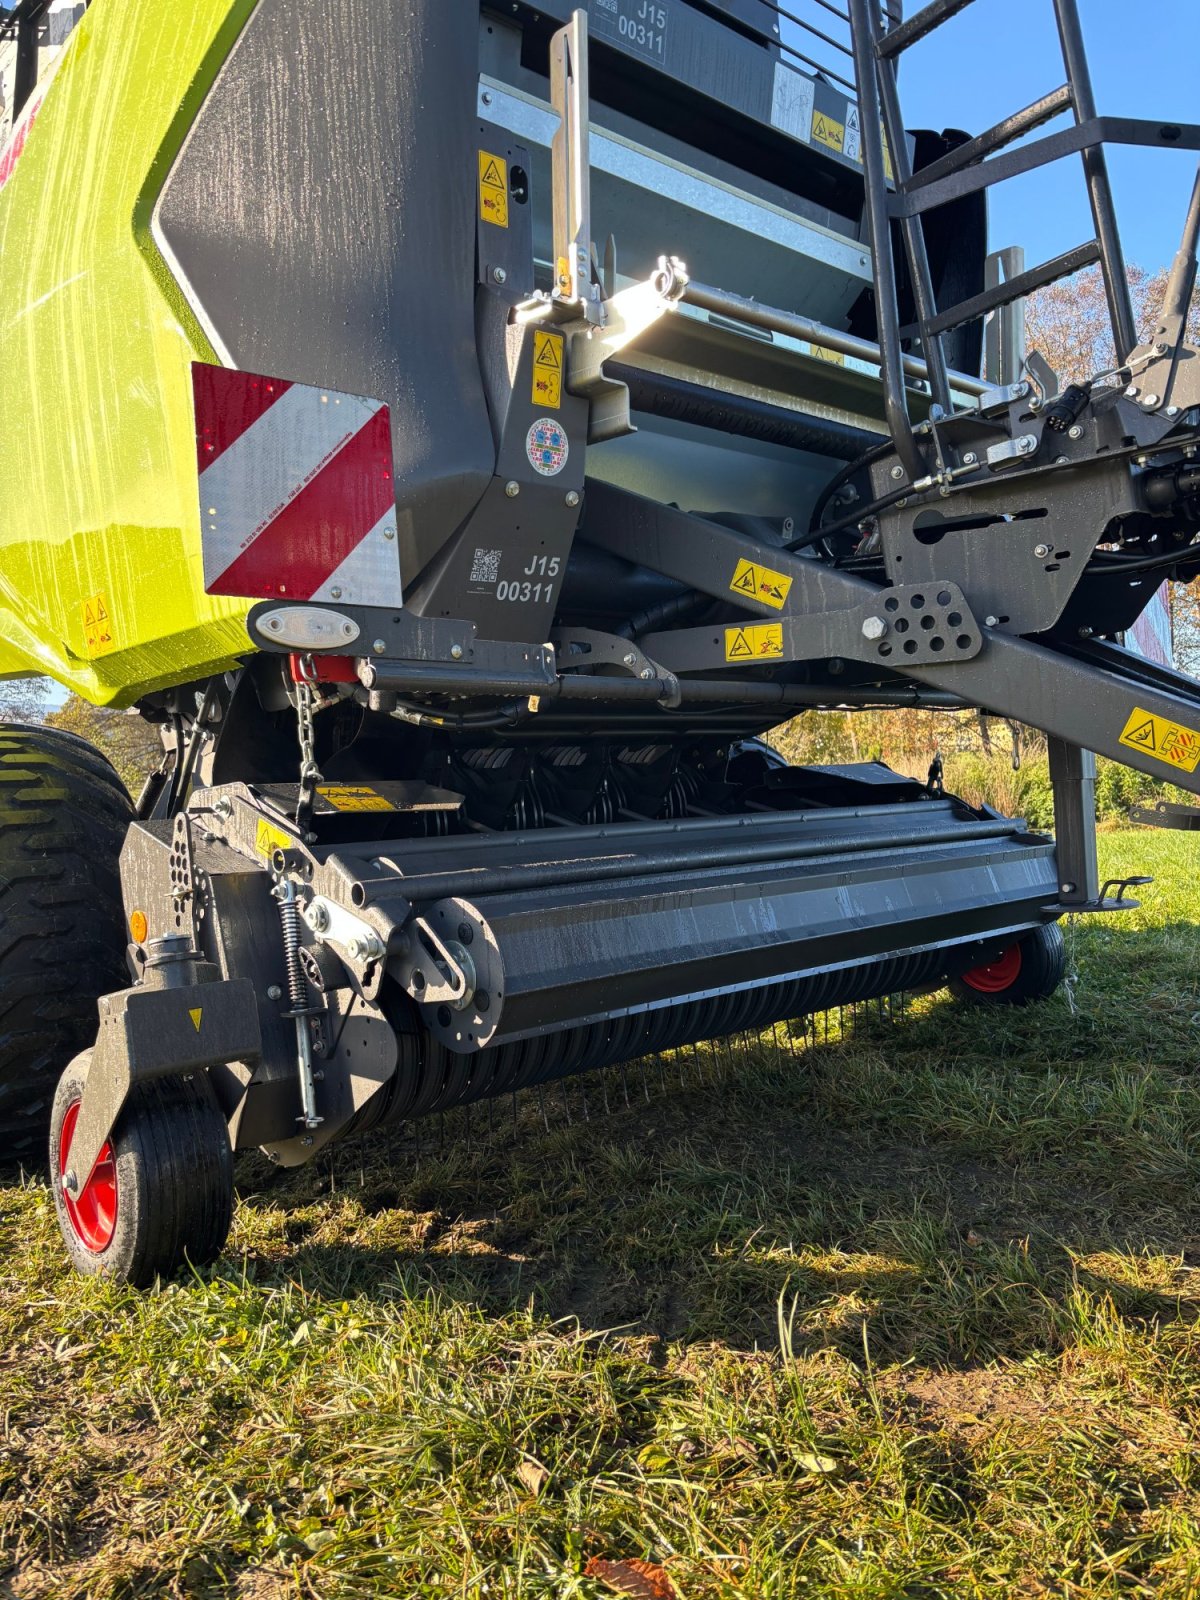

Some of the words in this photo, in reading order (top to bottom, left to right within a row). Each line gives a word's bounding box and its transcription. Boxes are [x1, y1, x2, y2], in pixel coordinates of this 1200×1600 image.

[638, 1, 666, 29] J15
[618, 15, 662, 54] 00311
[524, 555, 560, 577] J15
[496, 580, 553, 603] 00311
